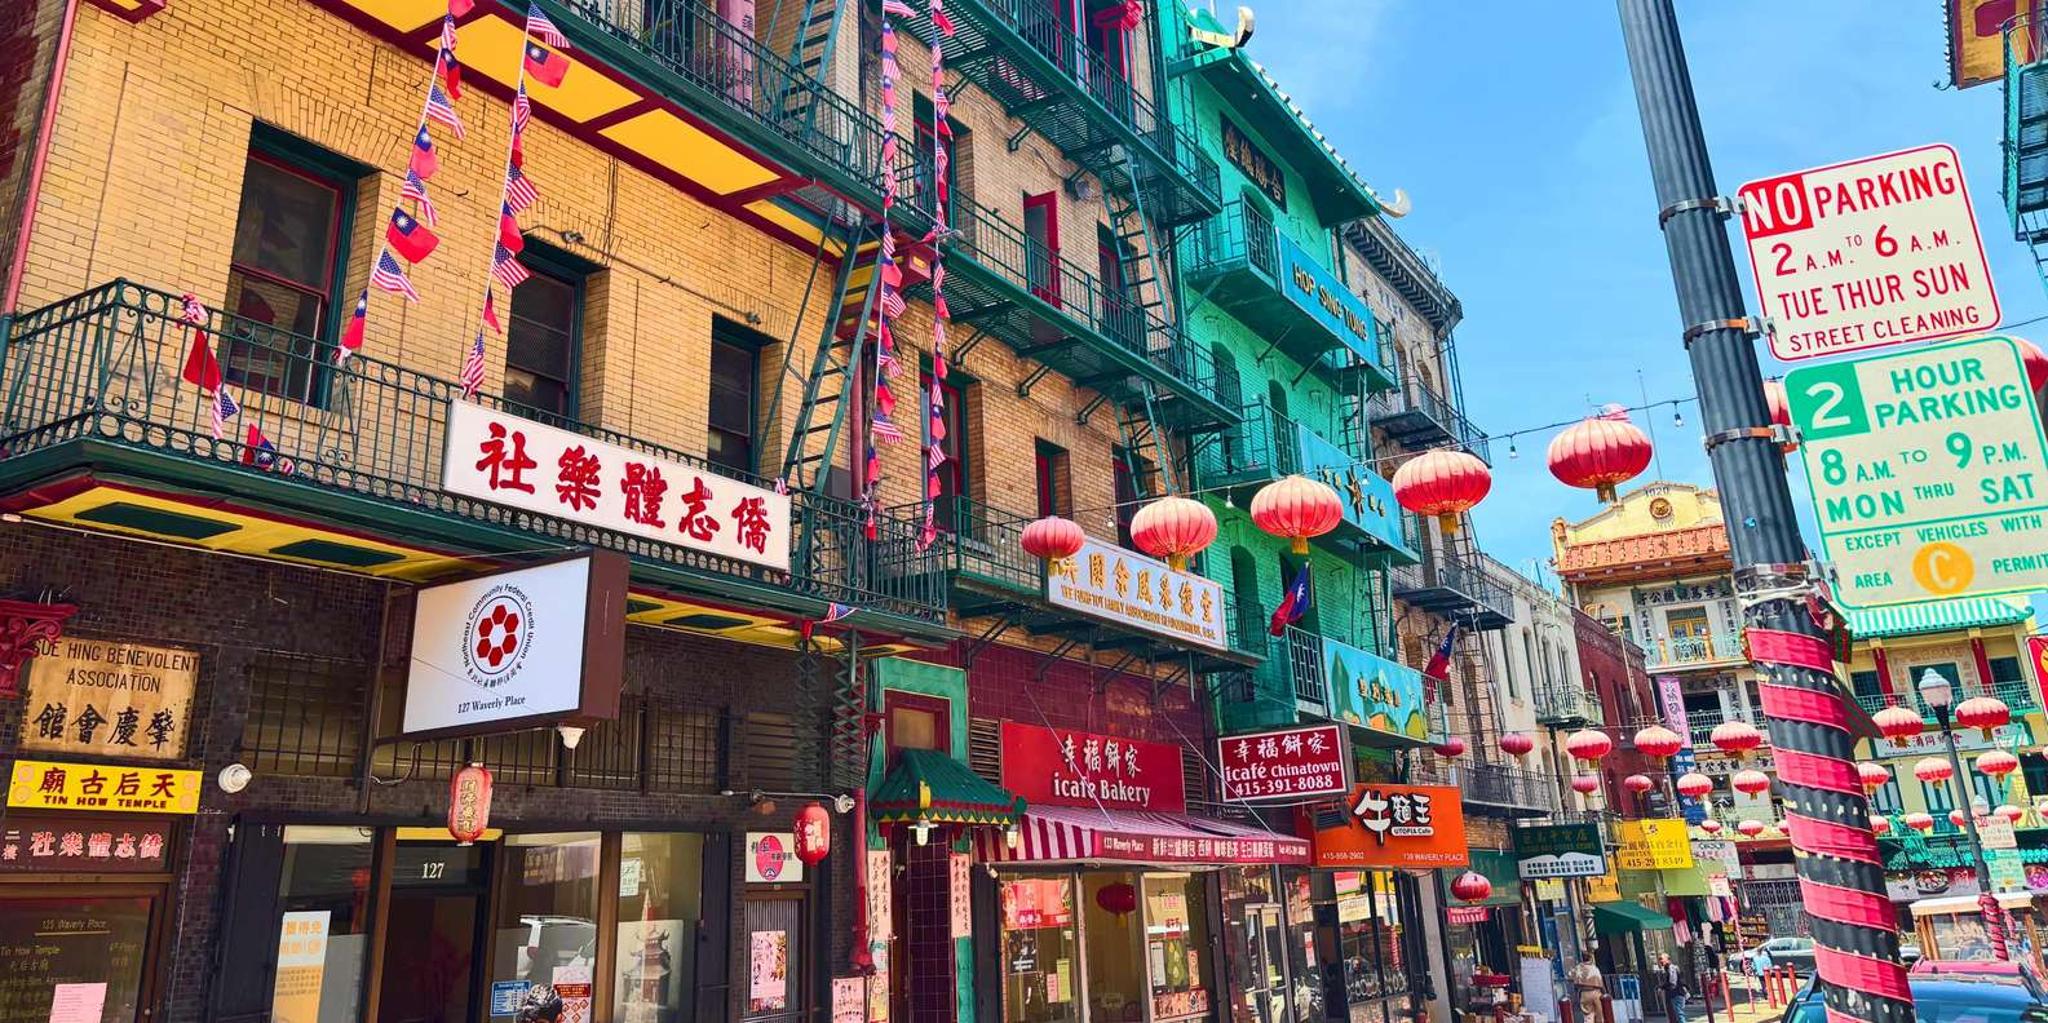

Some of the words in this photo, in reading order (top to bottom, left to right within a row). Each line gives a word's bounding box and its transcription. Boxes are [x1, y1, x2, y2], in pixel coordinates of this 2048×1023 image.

[1745, 182, 1803, 233] NO
[1813, 162, 1956, 219] PARKING
[1771, 243, 1797, 276] 2
[1806, 249, 1856, 272] A.M.
[1846, 234, 1863, 248] TO
[1875, 225, 1899, 257] 6
[1911, 230, 1962, 251] A.M.
[1292, 262, 1316, 296] HOP
[1318, 285, 1343, 320] SING
[1778, 287, 1828, 321] TUE
[1832, 274, 1905, 311] THUR
[1913, 262, 1970, 298] SUN
[1789, 324, 1865, 352] STREET
[1873, 306, 1980, 339] CLEANING
[1805, 381, 1851, 430] 2
[1890, 358, 1985, 394] HOUR
[1875, 385, 2022, 428] PARKING
[1820, 449, 1847, 486] 8
[1856, 461, 1896, 482] A.M.
[1900, 450, 1927, 465] TO
[1946, 432, 1972, 470] 9
[1983, 442, 2027, 465] P.M.
[1826, 491, 1905, 523] MON
[1913, 483, 1954, 500] THRU
[1980, 474, 2036, 504] SAT
[1845, 532, 1901, 552] EXCEPT
[1917, 521, 1988, 543] VEHICLES
[2001, 515, 2042, 532] WITH
[1855, 572, 1893, 589] AREA
[1929, 549, 1957, 589] C
[1992, 554, 2048, 574] PERMIT
[468, 584, 503, 621] Community
[504, 583, 528, 602] Federal
[525, 601, 535, 629] Credit
[107, 648, 200, 672] BENEVOLENT
[462, 622, 471, 667] Northeast
[521, 631, 535, 660] Union
[66, 668, 161, 693] ASSOCIATION
[458, 703, 470, 714] 127
[472, 697, 504, 711] Waverly
[504, 695, 526, 706] Place
[1061, 733, 1142, 778] 幸福餅家
[1234, 732, 1330, 764] 幸福餅家
[1226, 761, 1266, 783] icafé
[1235, 775, 1334, 796] 415-391-8088
[44, 795, 68, 805] TIN
[77, 797, 108, 807] HOW
[118, 799, 167, 809] TEMPLE
[1101, 779, 1151, 807] Bakery
[1113, 838, 1130, 853] Waverly
[1131, 838, 1144, 851] Place
[1415, 853, 1443, 861] WAVERLY
[421, 862, 445, 880] 127
